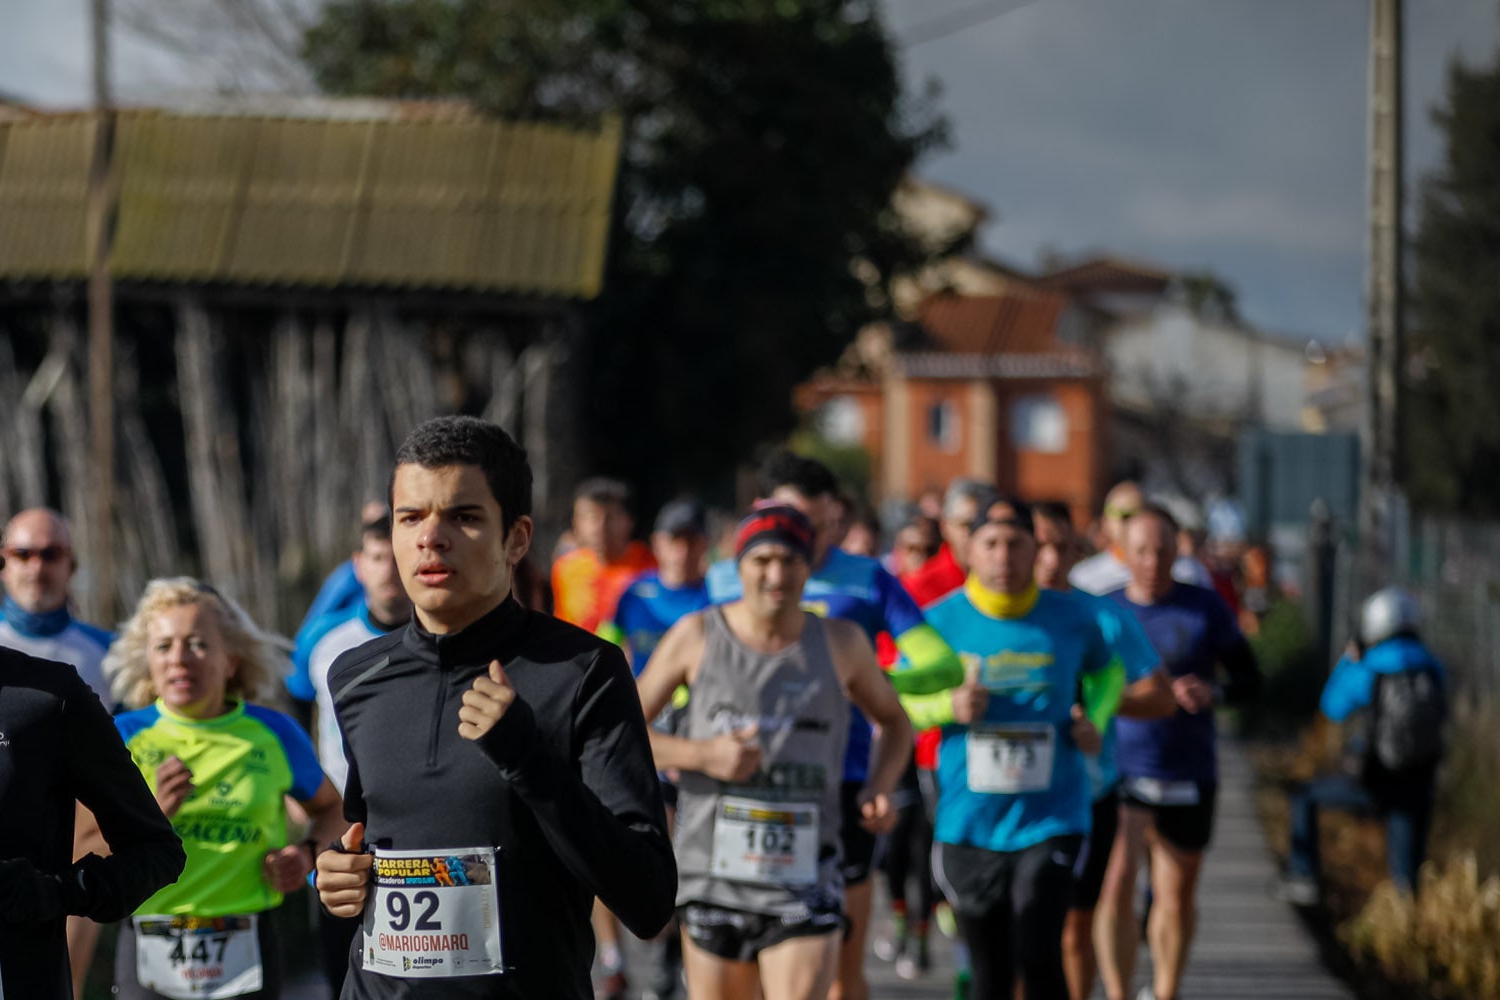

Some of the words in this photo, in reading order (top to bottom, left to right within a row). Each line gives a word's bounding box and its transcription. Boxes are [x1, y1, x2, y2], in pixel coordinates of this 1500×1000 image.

[378, 858, 430, 869] CARRERA
[378, 868, 431, 877] POPULAR
[386, 890, 442, 932] 92
[379, 932, 469, 951] @MARIOGMARQ
[168, 934, 229, 967] 447
[412, 956, 444, 966] olimpo
